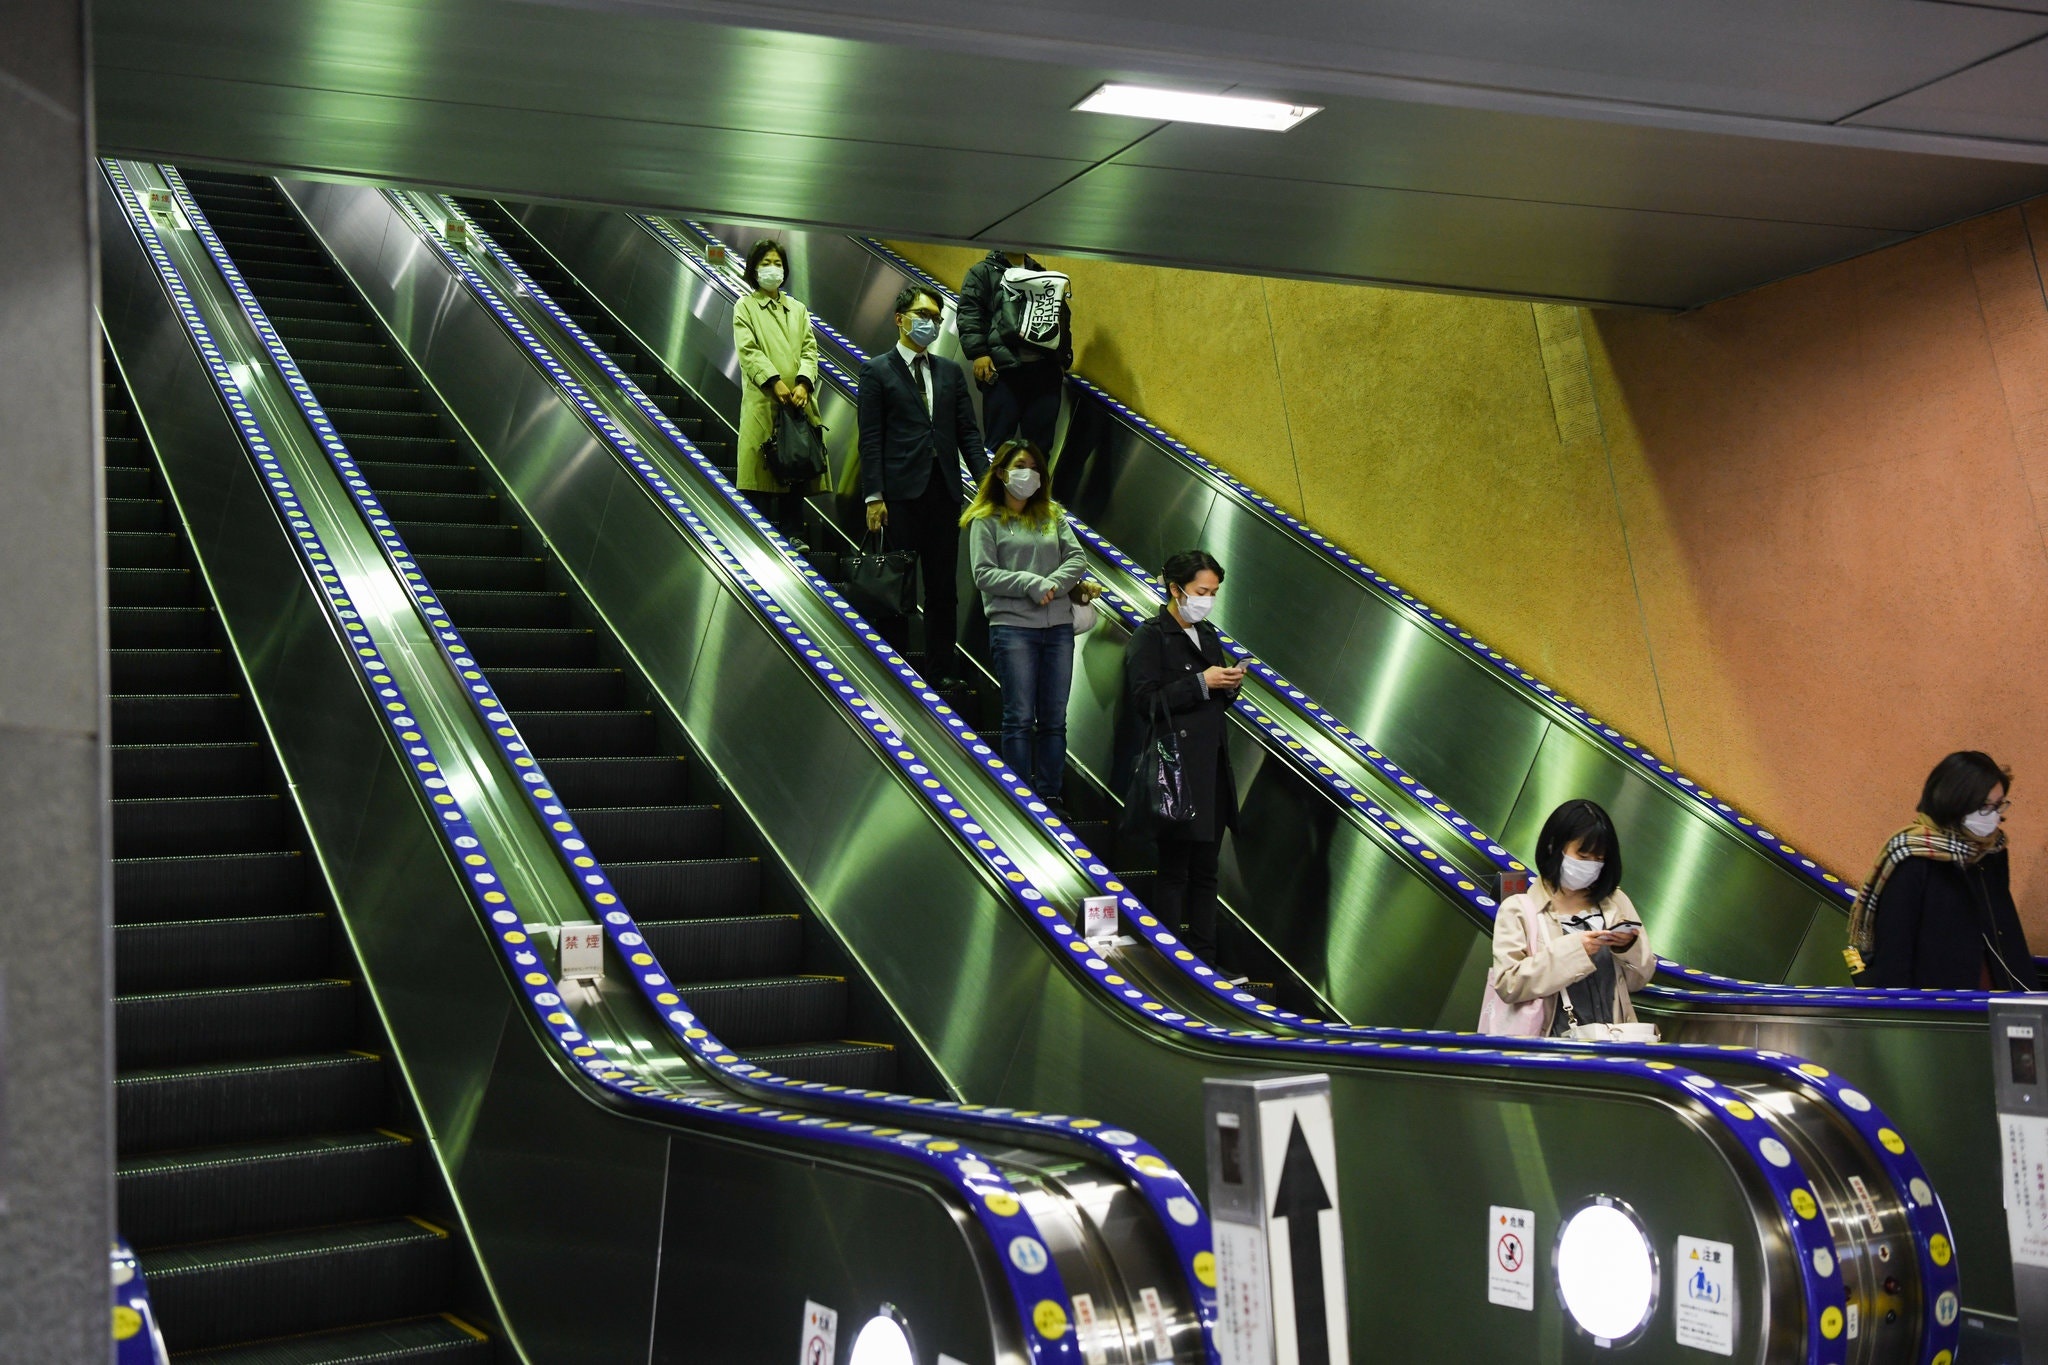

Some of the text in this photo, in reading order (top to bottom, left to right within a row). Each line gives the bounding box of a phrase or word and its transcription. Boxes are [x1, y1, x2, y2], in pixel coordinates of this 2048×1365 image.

[1032, 293, 1045, 321] FACE
[1042, 280, 1056, 323] NORTH
[1088, 905, 1116, 920] 禁煙
[565, 934, 600, 950] 禁煙
[1702, 1246, 1722, 1264] 注意
